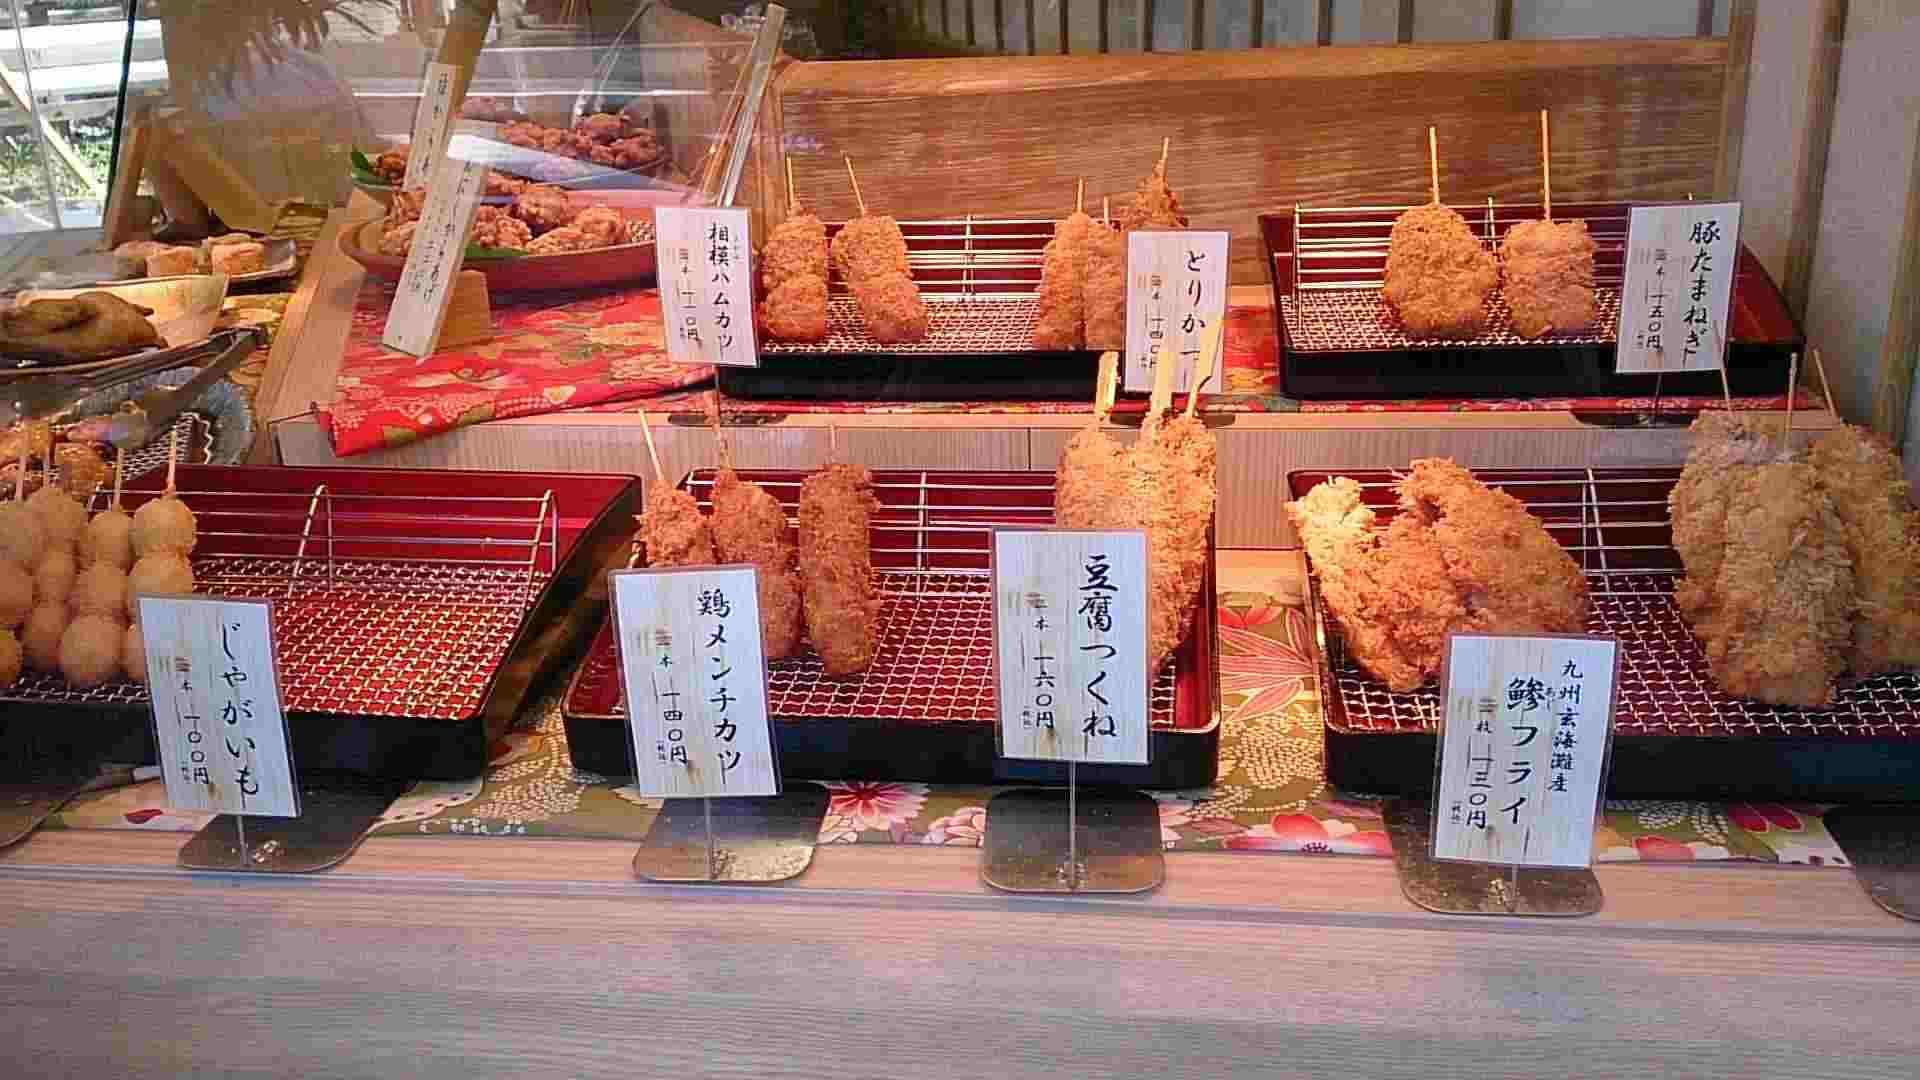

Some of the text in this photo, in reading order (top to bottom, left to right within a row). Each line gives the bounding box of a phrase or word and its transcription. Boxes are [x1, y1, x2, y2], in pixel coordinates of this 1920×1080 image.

[706, 221, 733, 348] 相模ハムカツ
[1683, 220, 1721, 354] 豚たまねぎ
[697, 589, 741, 770] 鶏メンチカツ
[1033, 656, 1056, 729] 一六〇円
[1078, 554, 1119, 738] 豆腐つくね
[661, 692, 688, 764] 一四〇円
